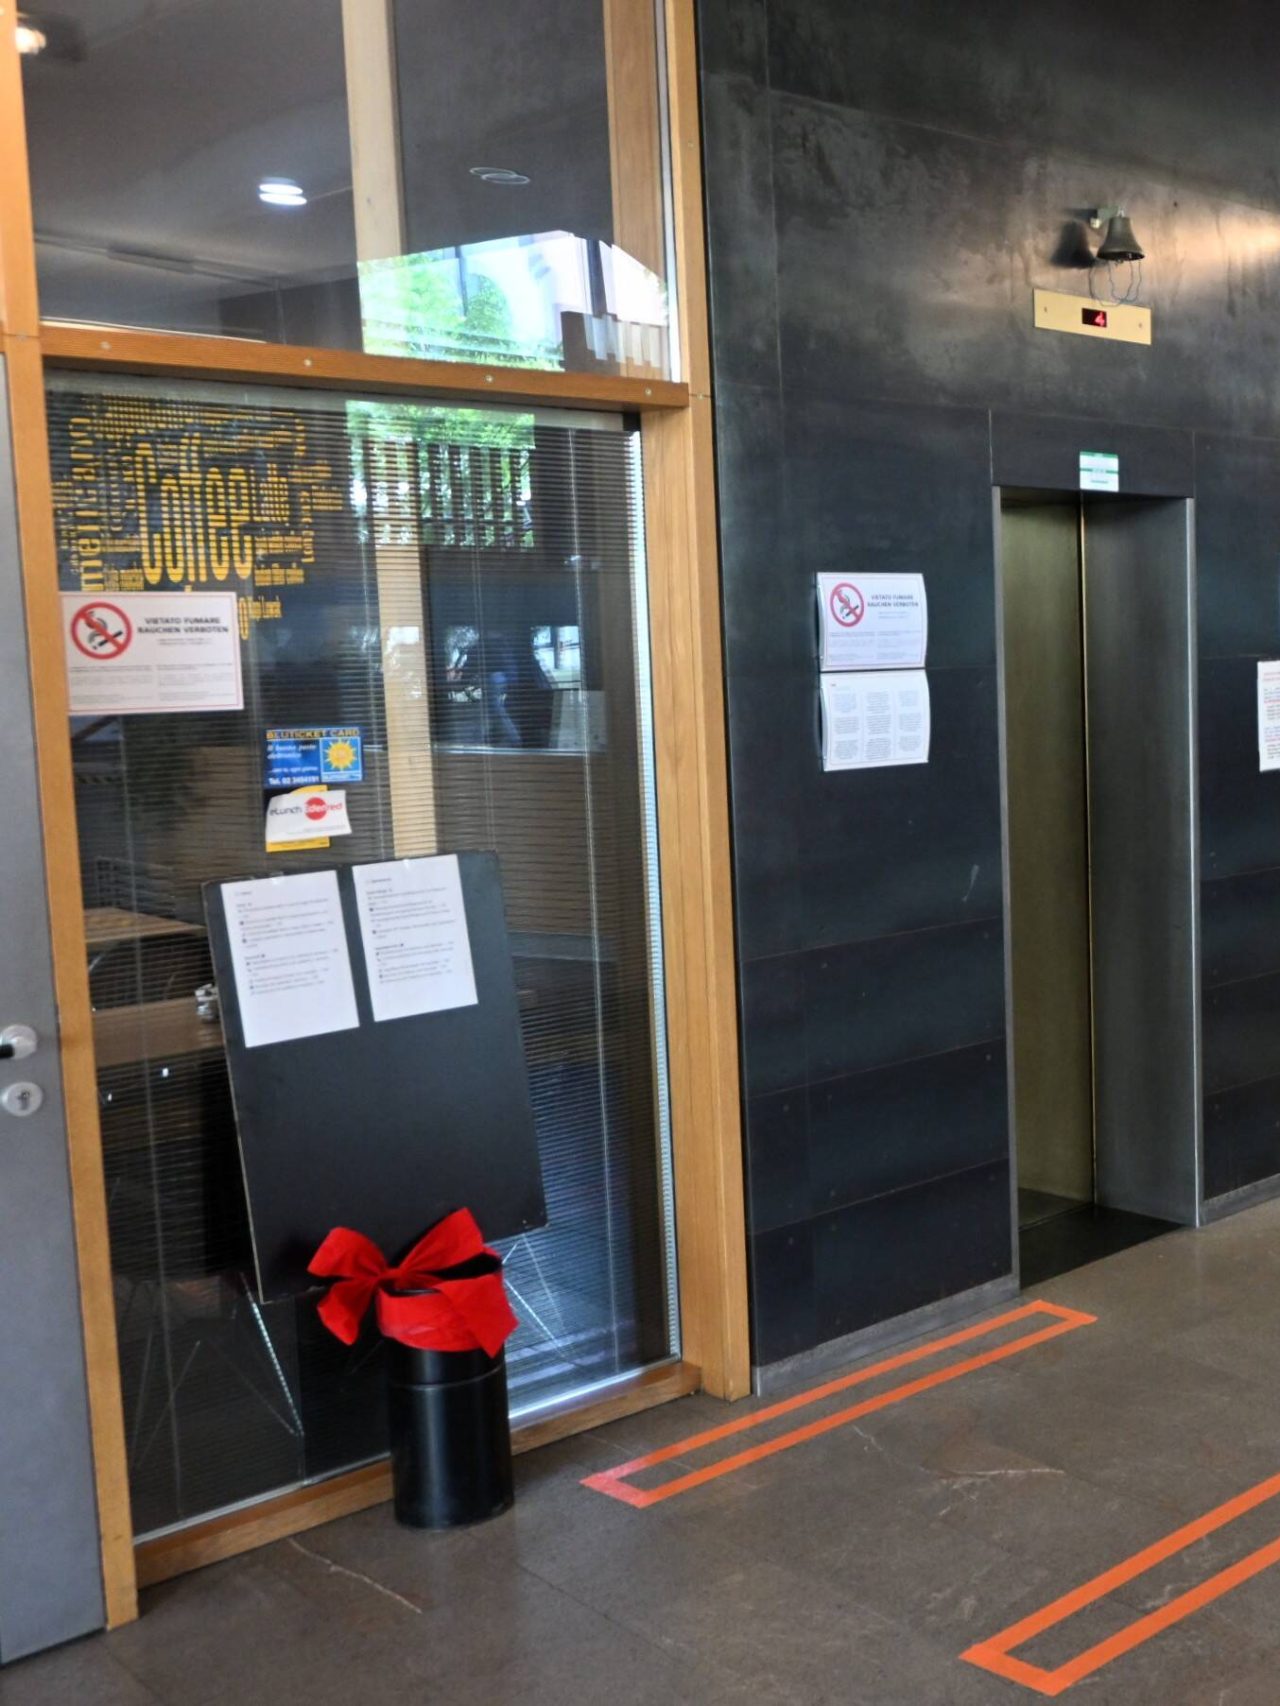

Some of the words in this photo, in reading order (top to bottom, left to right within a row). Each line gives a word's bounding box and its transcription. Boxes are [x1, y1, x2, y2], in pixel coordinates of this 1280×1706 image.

[135, 432, 252, 584] Coffee
[144, 617, 181, 625] VIETATO
[183, 617, 220, 625] FUMARE
